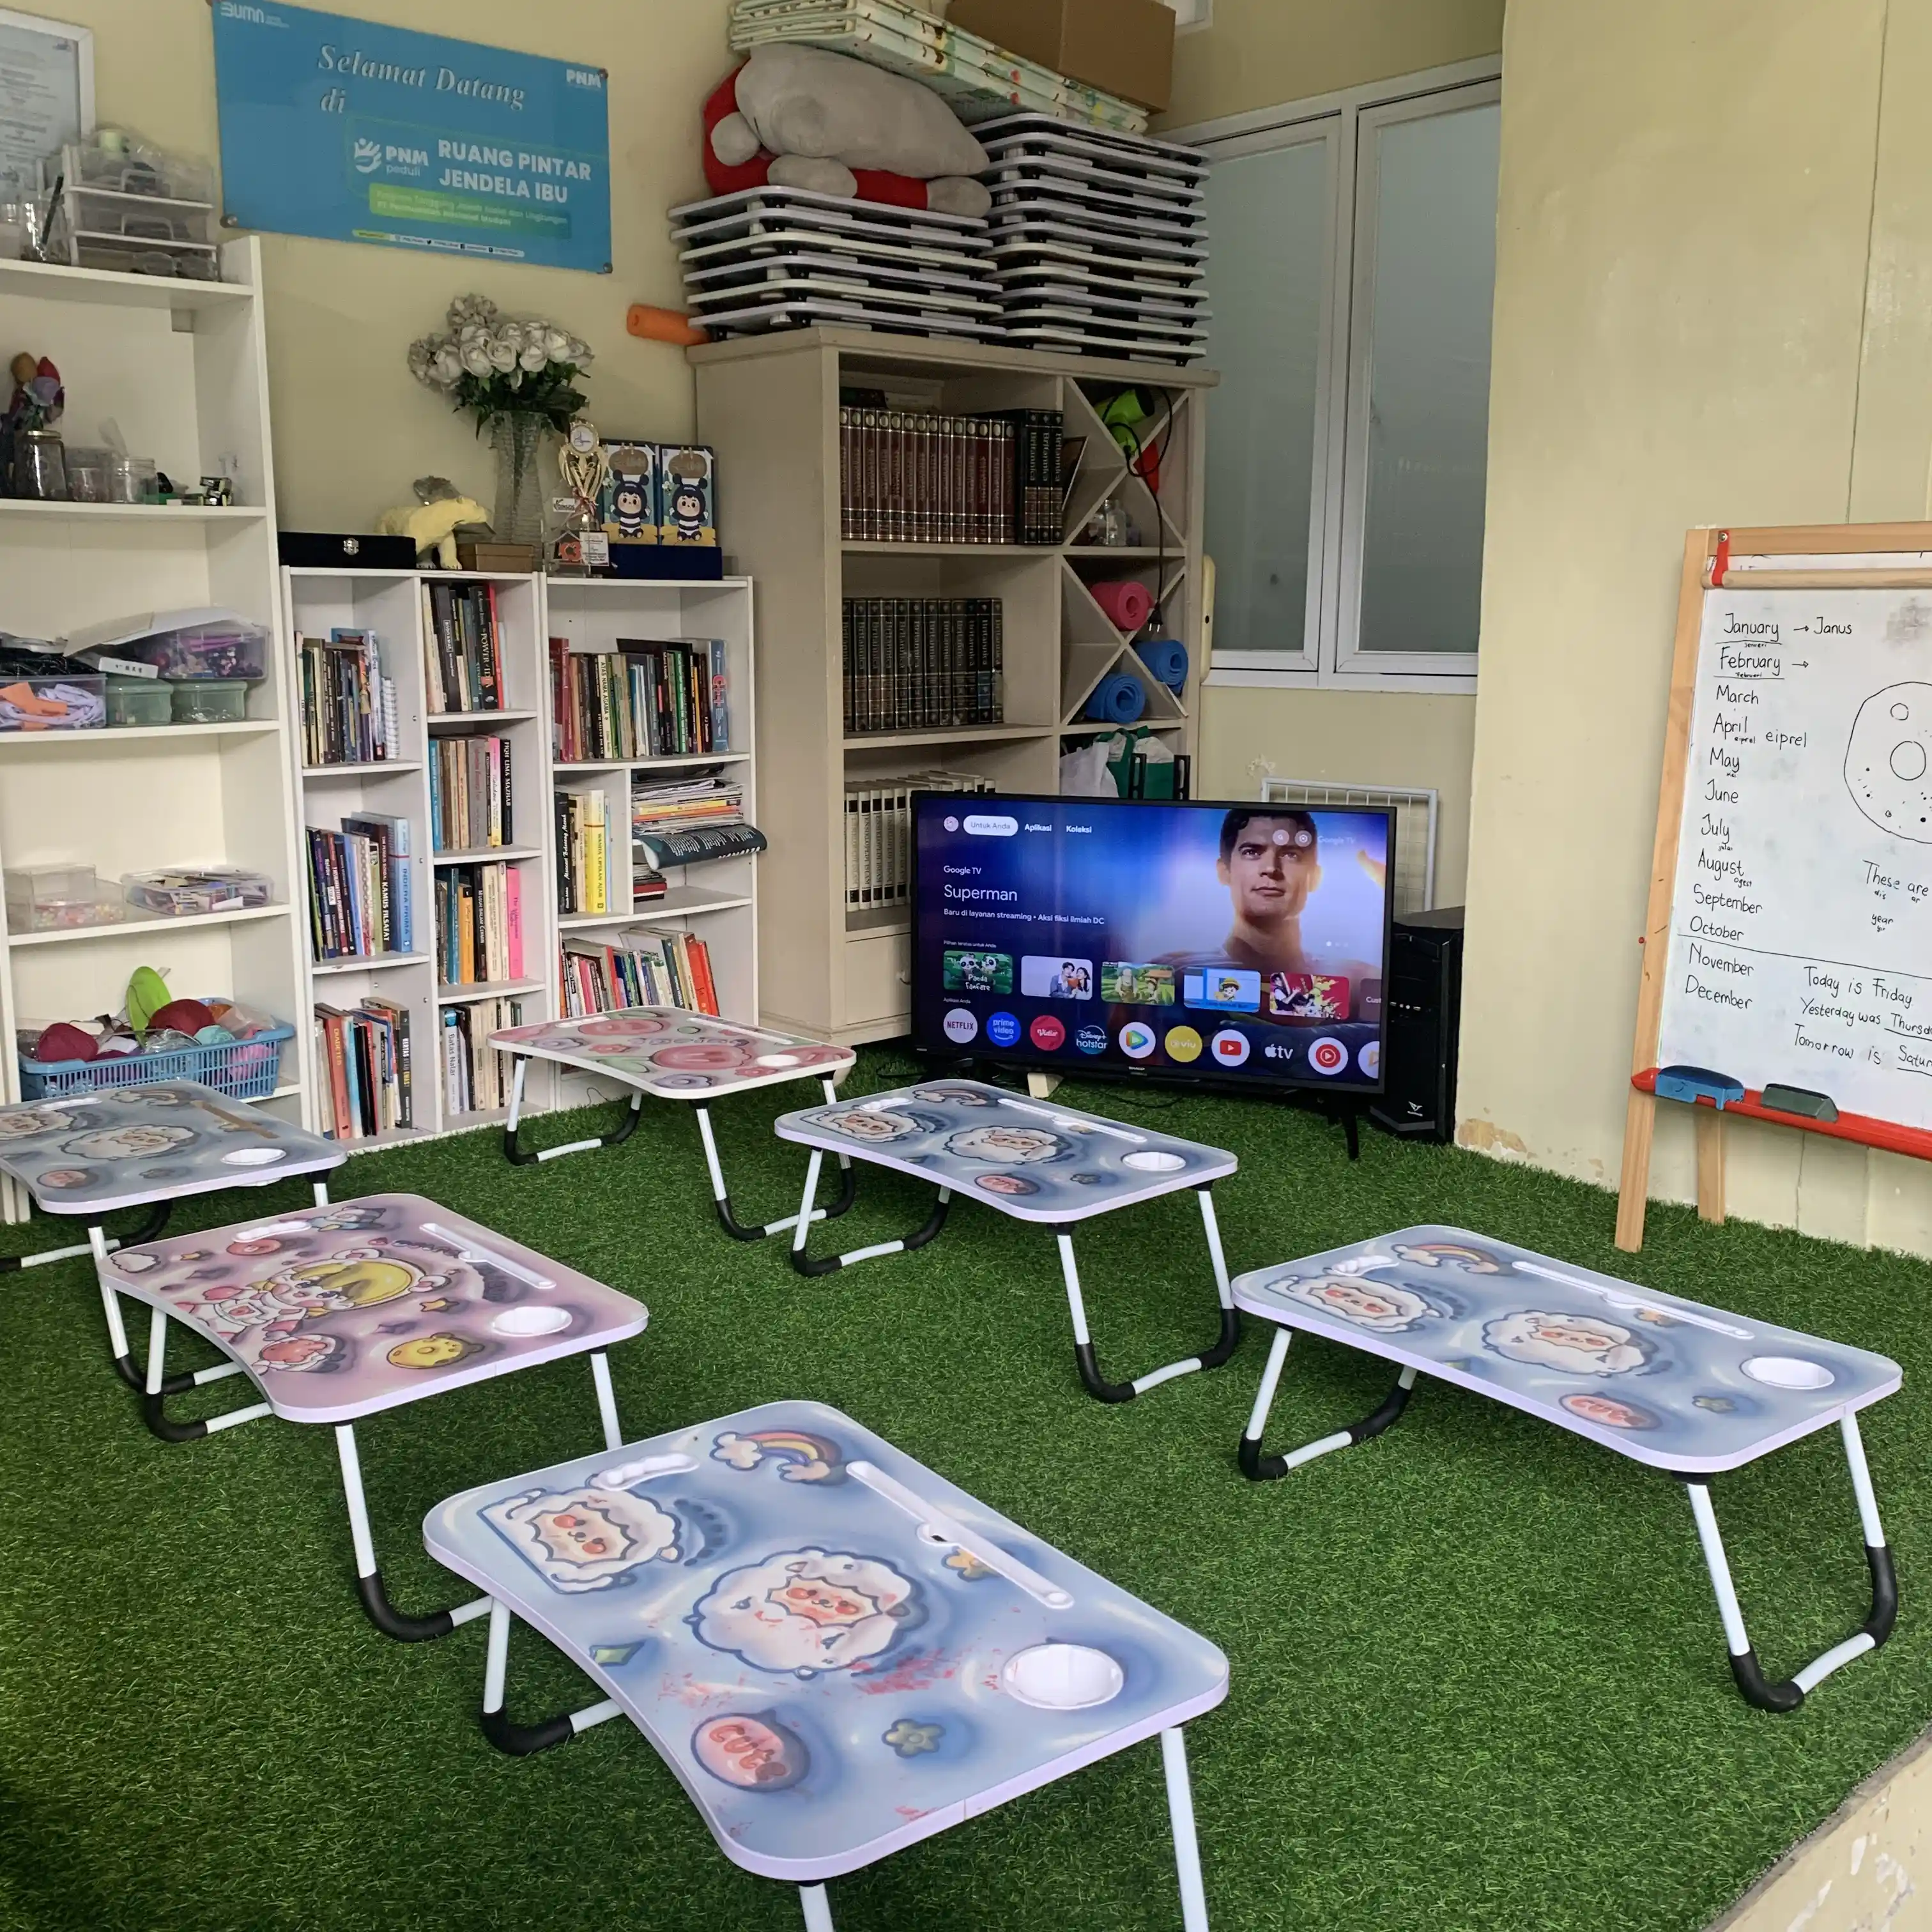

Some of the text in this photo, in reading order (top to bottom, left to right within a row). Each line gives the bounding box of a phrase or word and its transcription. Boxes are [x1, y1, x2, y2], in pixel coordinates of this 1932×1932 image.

[317, 43, 525, 111] Selamat Datang
[566, 69, 602, 88] PNM
[320, 86, 346, 114] di
[385, 146, 429, 167] PNM
[438, 139, 591, 180] RUANG PINTAR
[386, 164, 421, 176] peduli
[438, 169, 568, 203] JENDELA IBU
[1723, 613, 1852, 641] January Janus
[1720, 646, 1781, 676] February
[1716, 684, 1759, 704] March
[1713, 712, 1747, 740] April
[1766, 729, 1807, 751] eiprel
[1710, 747, 1740, 773] May
[1705, 778, 1739, 804] June
[970, 821, 1011, 830] Untuk Anda
[1024, 823, 1052, 832] Aplikasi
[1066, 825, 1092, 834] Koleksi
[1701, 813, 1729, 844] July
[943, 865, 970, 876] Google
[1698, 847, 1744, 881] August
[1862, 859, 1929, 896] These are
[944, 884, 1018, 901] Superman
[1693, 883, 1763, 914] September
[944, 908, 960, 916] Baru
[969, 910, 995, 919] layanan
[997, 912, 1032, 922] streaming
[1038, 914, 1054, 922] Aksi
[1054, 914, 1069, 923] fiksi
[1871, 914, 1894, 925] year
[1690, 916, 1744, 942] October
[1689, 942, 1754, 977] November
[1685, 975, 1753, 1009] December
[1804, 966, 1840, 998] Today
[1848, 977, 1862, 994] is
[993, 1019, 1015, 1027] prime
[1800, 997, 1854, 1027] Yesterday
[1858, 1012, 1881, 1025] was
[947, 1020, 974, 1031] NETFLIX
[993, 1027, 1014, 1035] video
[1076, 1039, 1108, 1050] hotstar
[1181, 1041, 1196, 1049] viu
[1277, 1046, 1293, 1060] tv
[1795, 1023, 1854, 1059] Tomorrow
[1868, 1045, 1881, 1065] is
